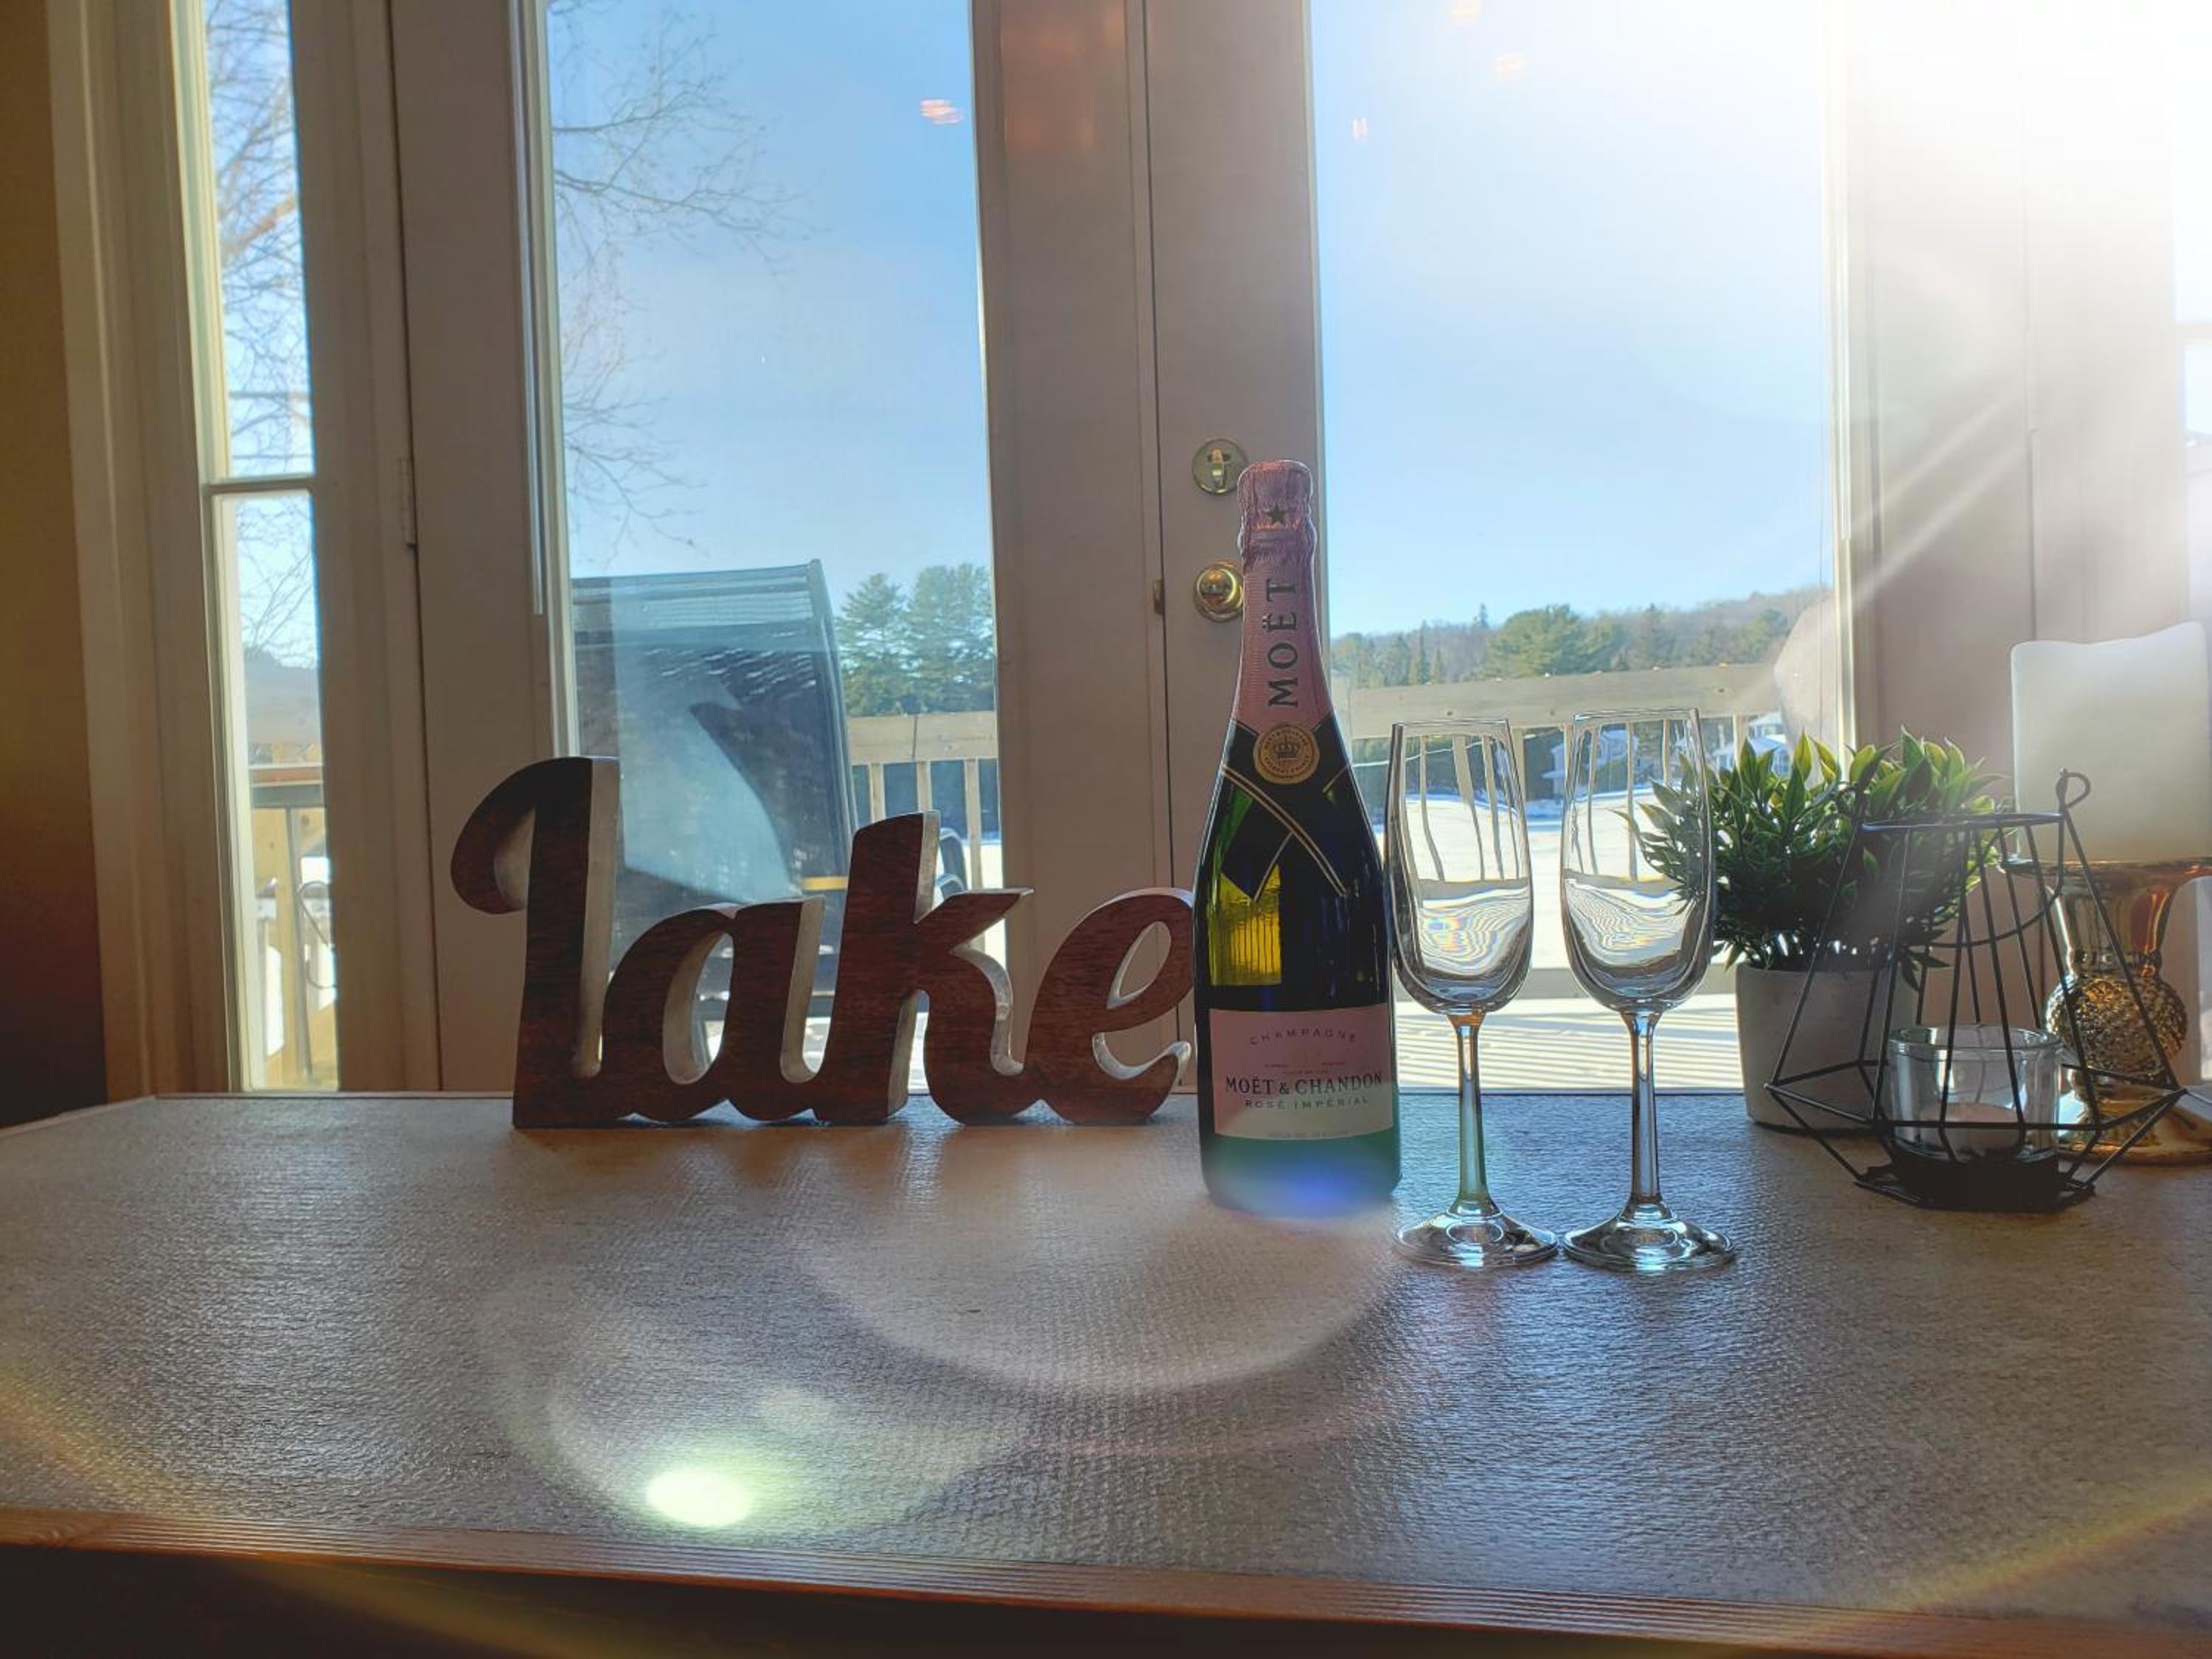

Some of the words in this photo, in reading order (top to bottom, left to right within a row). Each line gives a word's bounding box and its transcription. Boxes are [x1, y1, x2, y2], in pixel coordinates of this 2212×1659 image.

[525, 578, 561, 709] MOËT
[1250, 1029, 1357, 1045] CHAMPAGNE
[1279, 1082, 1290, 1095] &
[1295, 1071, 1382, 1095] CHANDON
